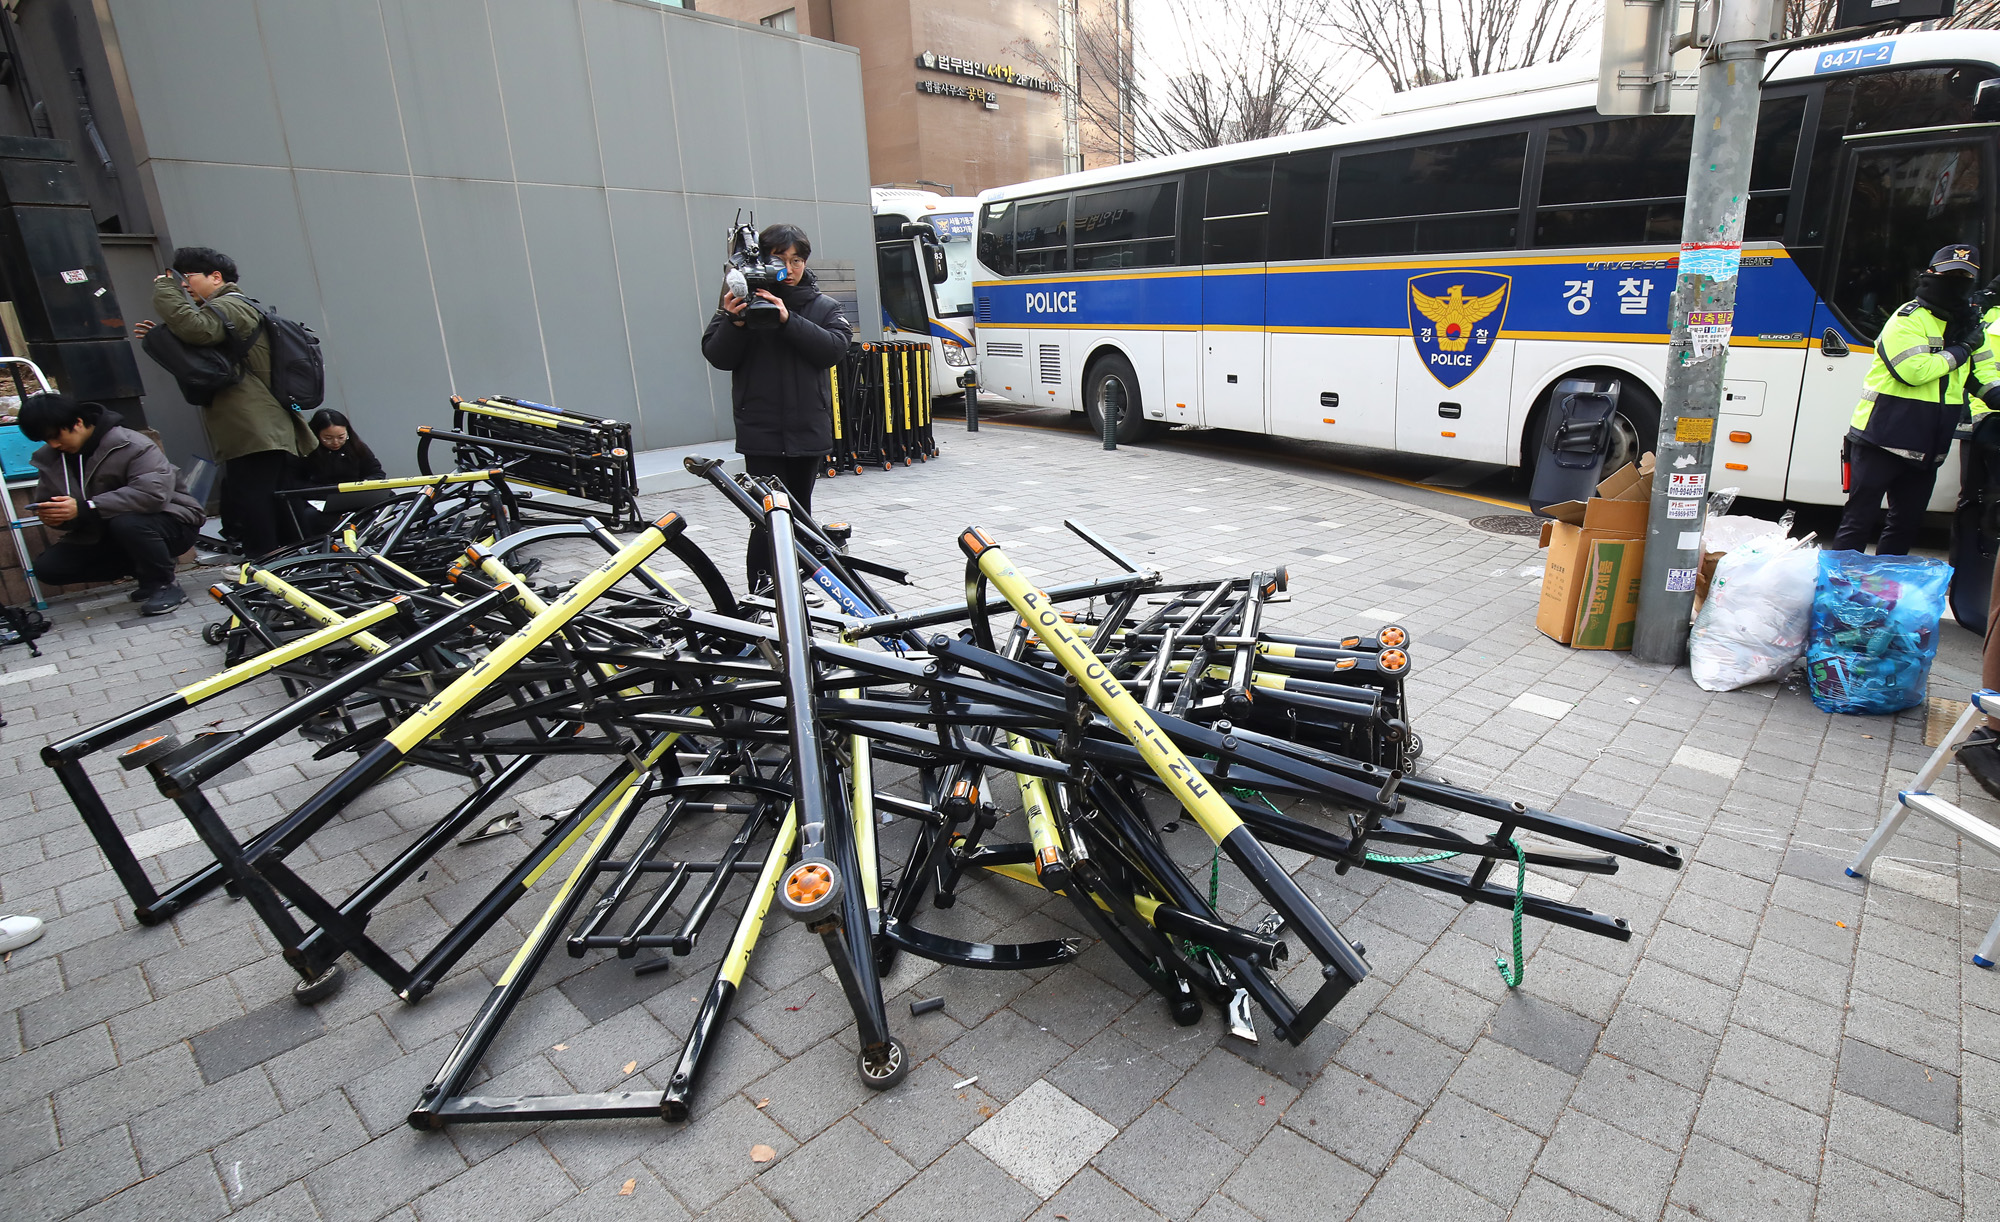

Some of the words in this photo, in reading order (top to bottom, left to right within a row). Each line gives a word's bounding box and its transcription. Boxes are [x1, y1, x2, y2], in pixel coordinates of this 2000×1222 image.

[938, 54, 985, 78] 법무법인
[1821, 45, 1890, 69] 84기-2
[1586, 259, 1667, 271] UNIVERSE
[1025, 291, 1077, 313] POLICE
[1430, 353, 1472, 366] POLICE
[1022, 591, 1121, 700] POLICE
[1133, 719, 1208, 799] LINE
